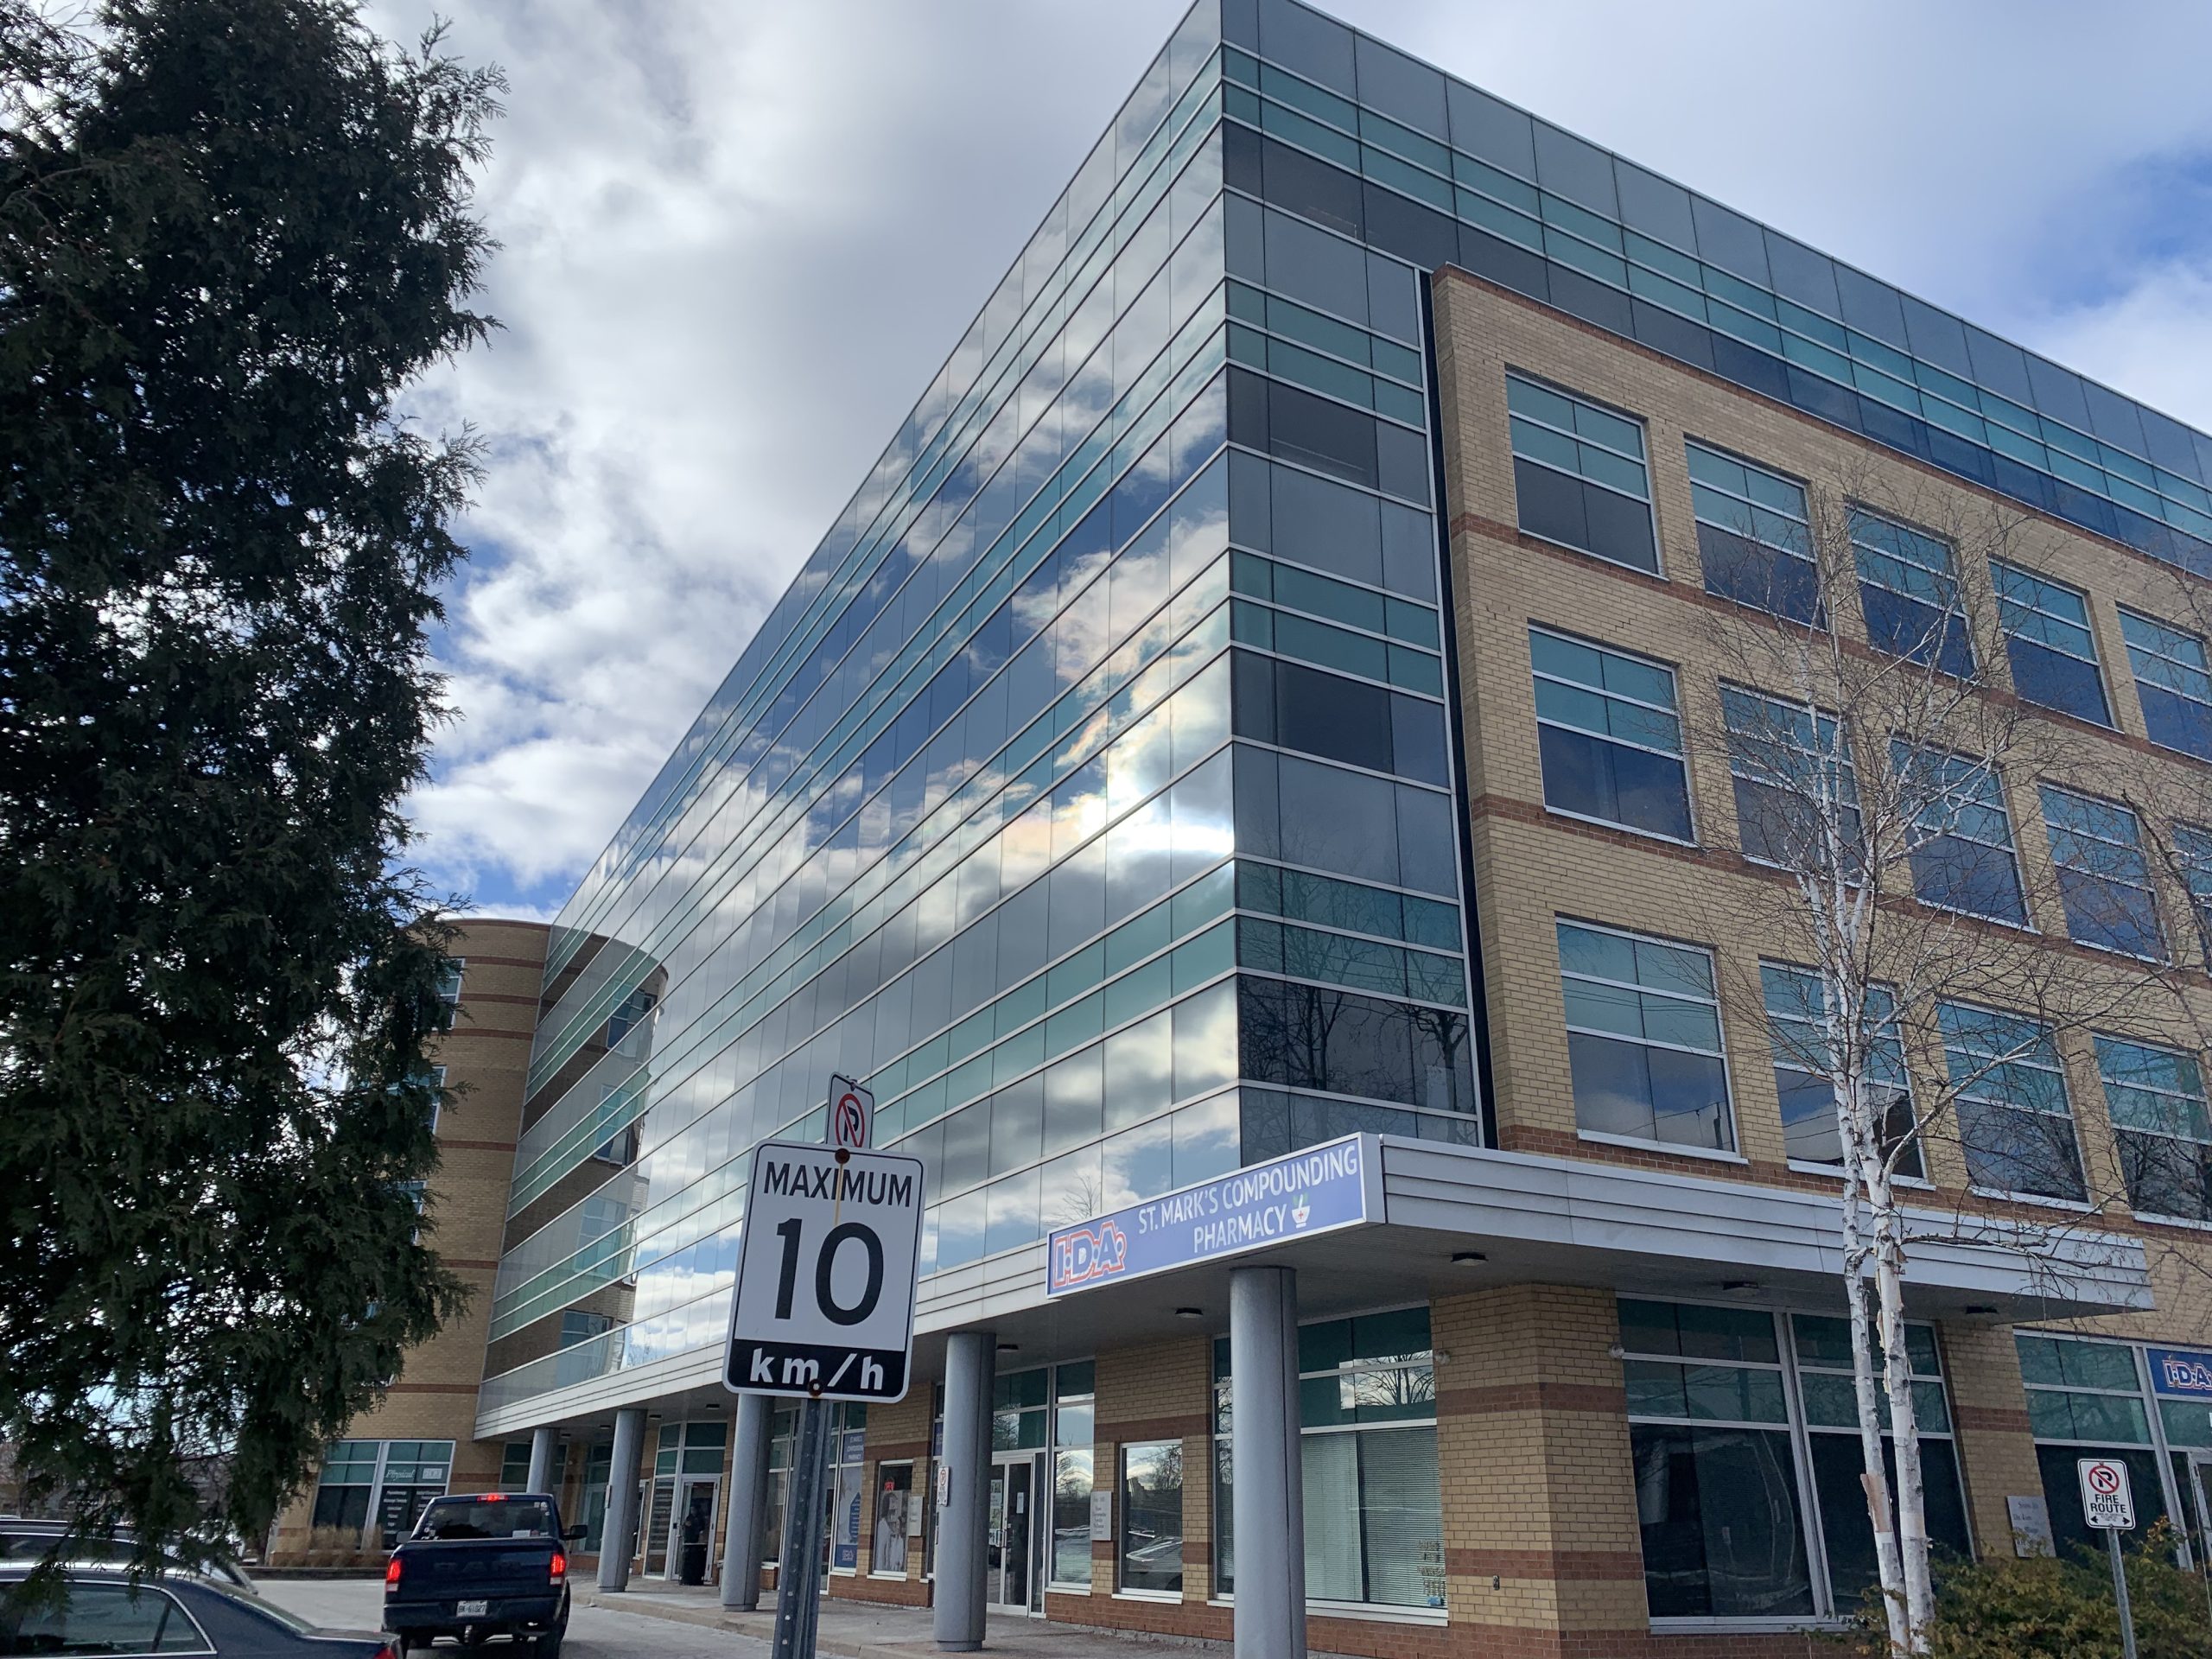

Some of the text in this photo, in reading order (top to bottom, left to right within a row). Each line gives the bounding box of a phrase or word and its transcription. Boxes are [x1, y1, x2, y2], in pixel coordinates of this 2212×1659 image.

[764, 1161, 912, 1208] MAXIMUM
[1138, 1145, 1357, 1235] ST. MARK'S COMPOUNDING
[1193, 1203, 1287, 1254] PHARMACY
[774, 1217, 884, 1326] 10
[749, 1347, 884, 1390] km/h
[2090, 1503, 2126, 1514] ROUTE
[2094, 1494, 2120, 1504] FIRE
